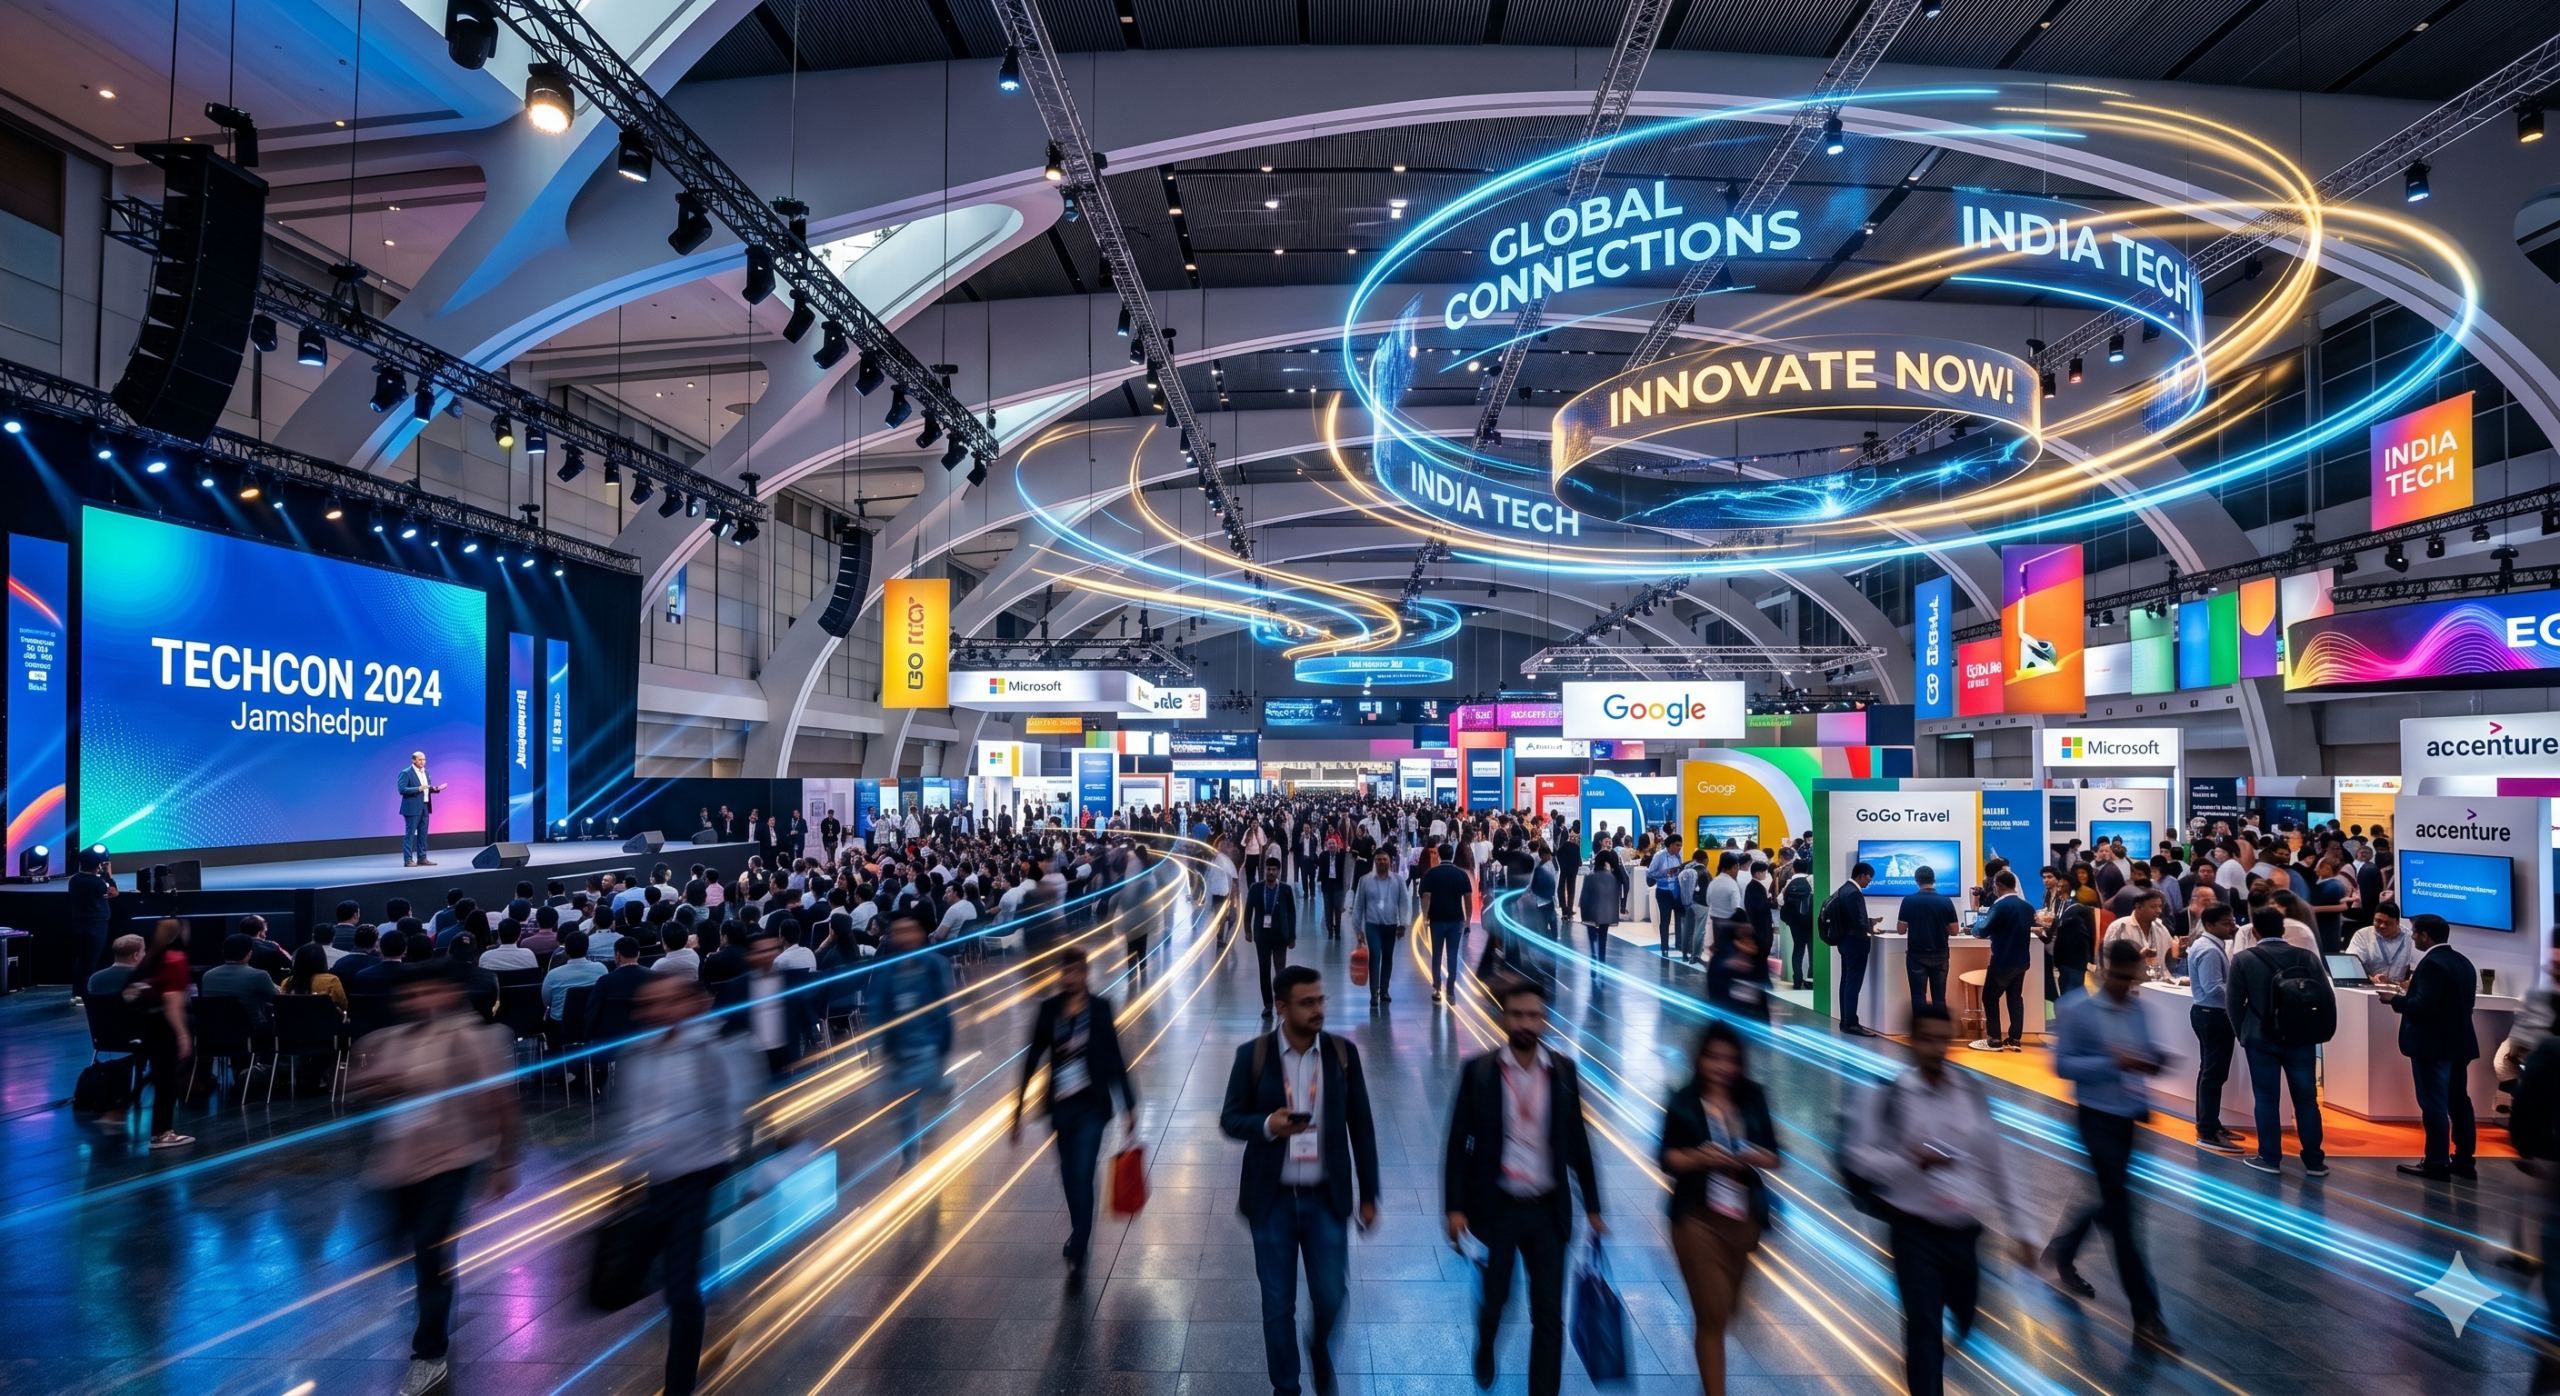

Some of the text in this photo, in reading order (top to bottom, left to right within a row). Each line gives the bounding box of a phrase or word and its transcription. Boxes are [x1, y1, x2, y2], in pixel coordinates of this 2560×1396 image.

[1490, 180, 1683, 266] GLOBAL
[1444, 210, 1802, 330] CONNECTIONS
[1963, 205, 2191, 311] INDIA TECH
[1610, 350, 2014, 428] INNOVATE NOW!
[2384, 429, 2459, 473] INDIA
[2385, 456, 2455, 497] TECH
[1411, 460, 1579, 537] INDIA TECH
[151, 636, 442, 707] TECHCON 2024
[1008, 680, 1062, 692] Microsoft
[231, 701, 388, 742] Jamshedpur
[1603, 693, 1706, 727] Google
[2088, 740, 2160, 755] Microsoft
[2426, 734, 2559, 757] accenture
[1856, 808, 1950, 822] GoGo Travel
[2415, 822, 2511, 842] accenture
